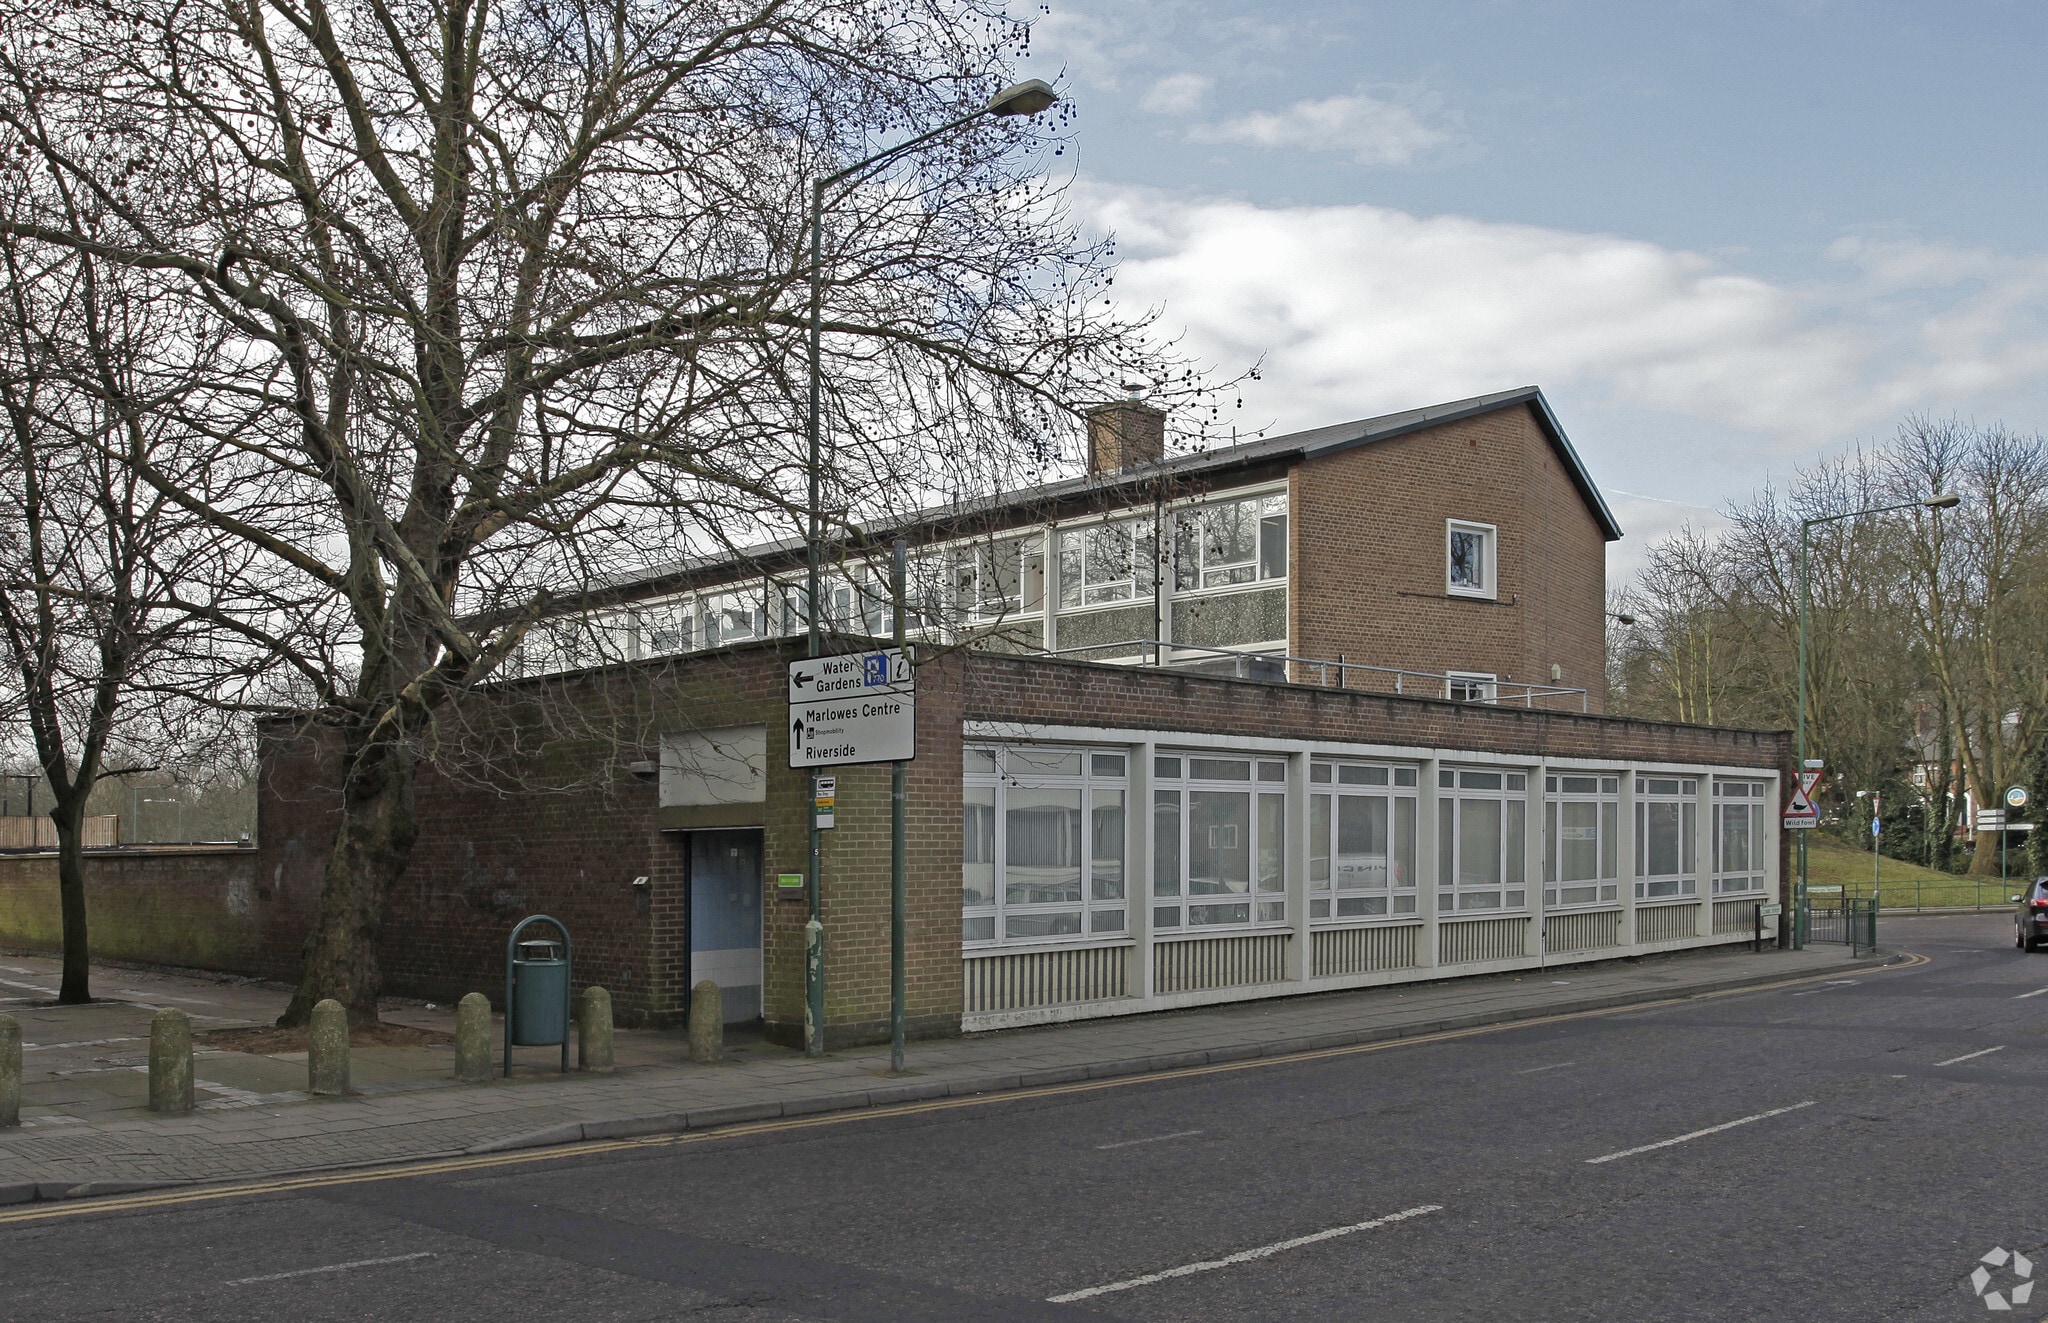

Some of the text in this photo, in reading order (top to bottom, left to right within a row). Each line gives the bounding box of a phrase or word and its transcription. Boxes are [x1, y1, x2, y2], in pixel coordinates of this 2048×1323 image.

[823, 662, 854, 675] Water
[817, 678, 861, 692] Gardens
[806, 703, 900, 722] Marlowes Centre
[815, 728, 844, 736] Shopmobility
[806, 744, 856, 759] Riverside
[814, 848, 819, 856] 5
